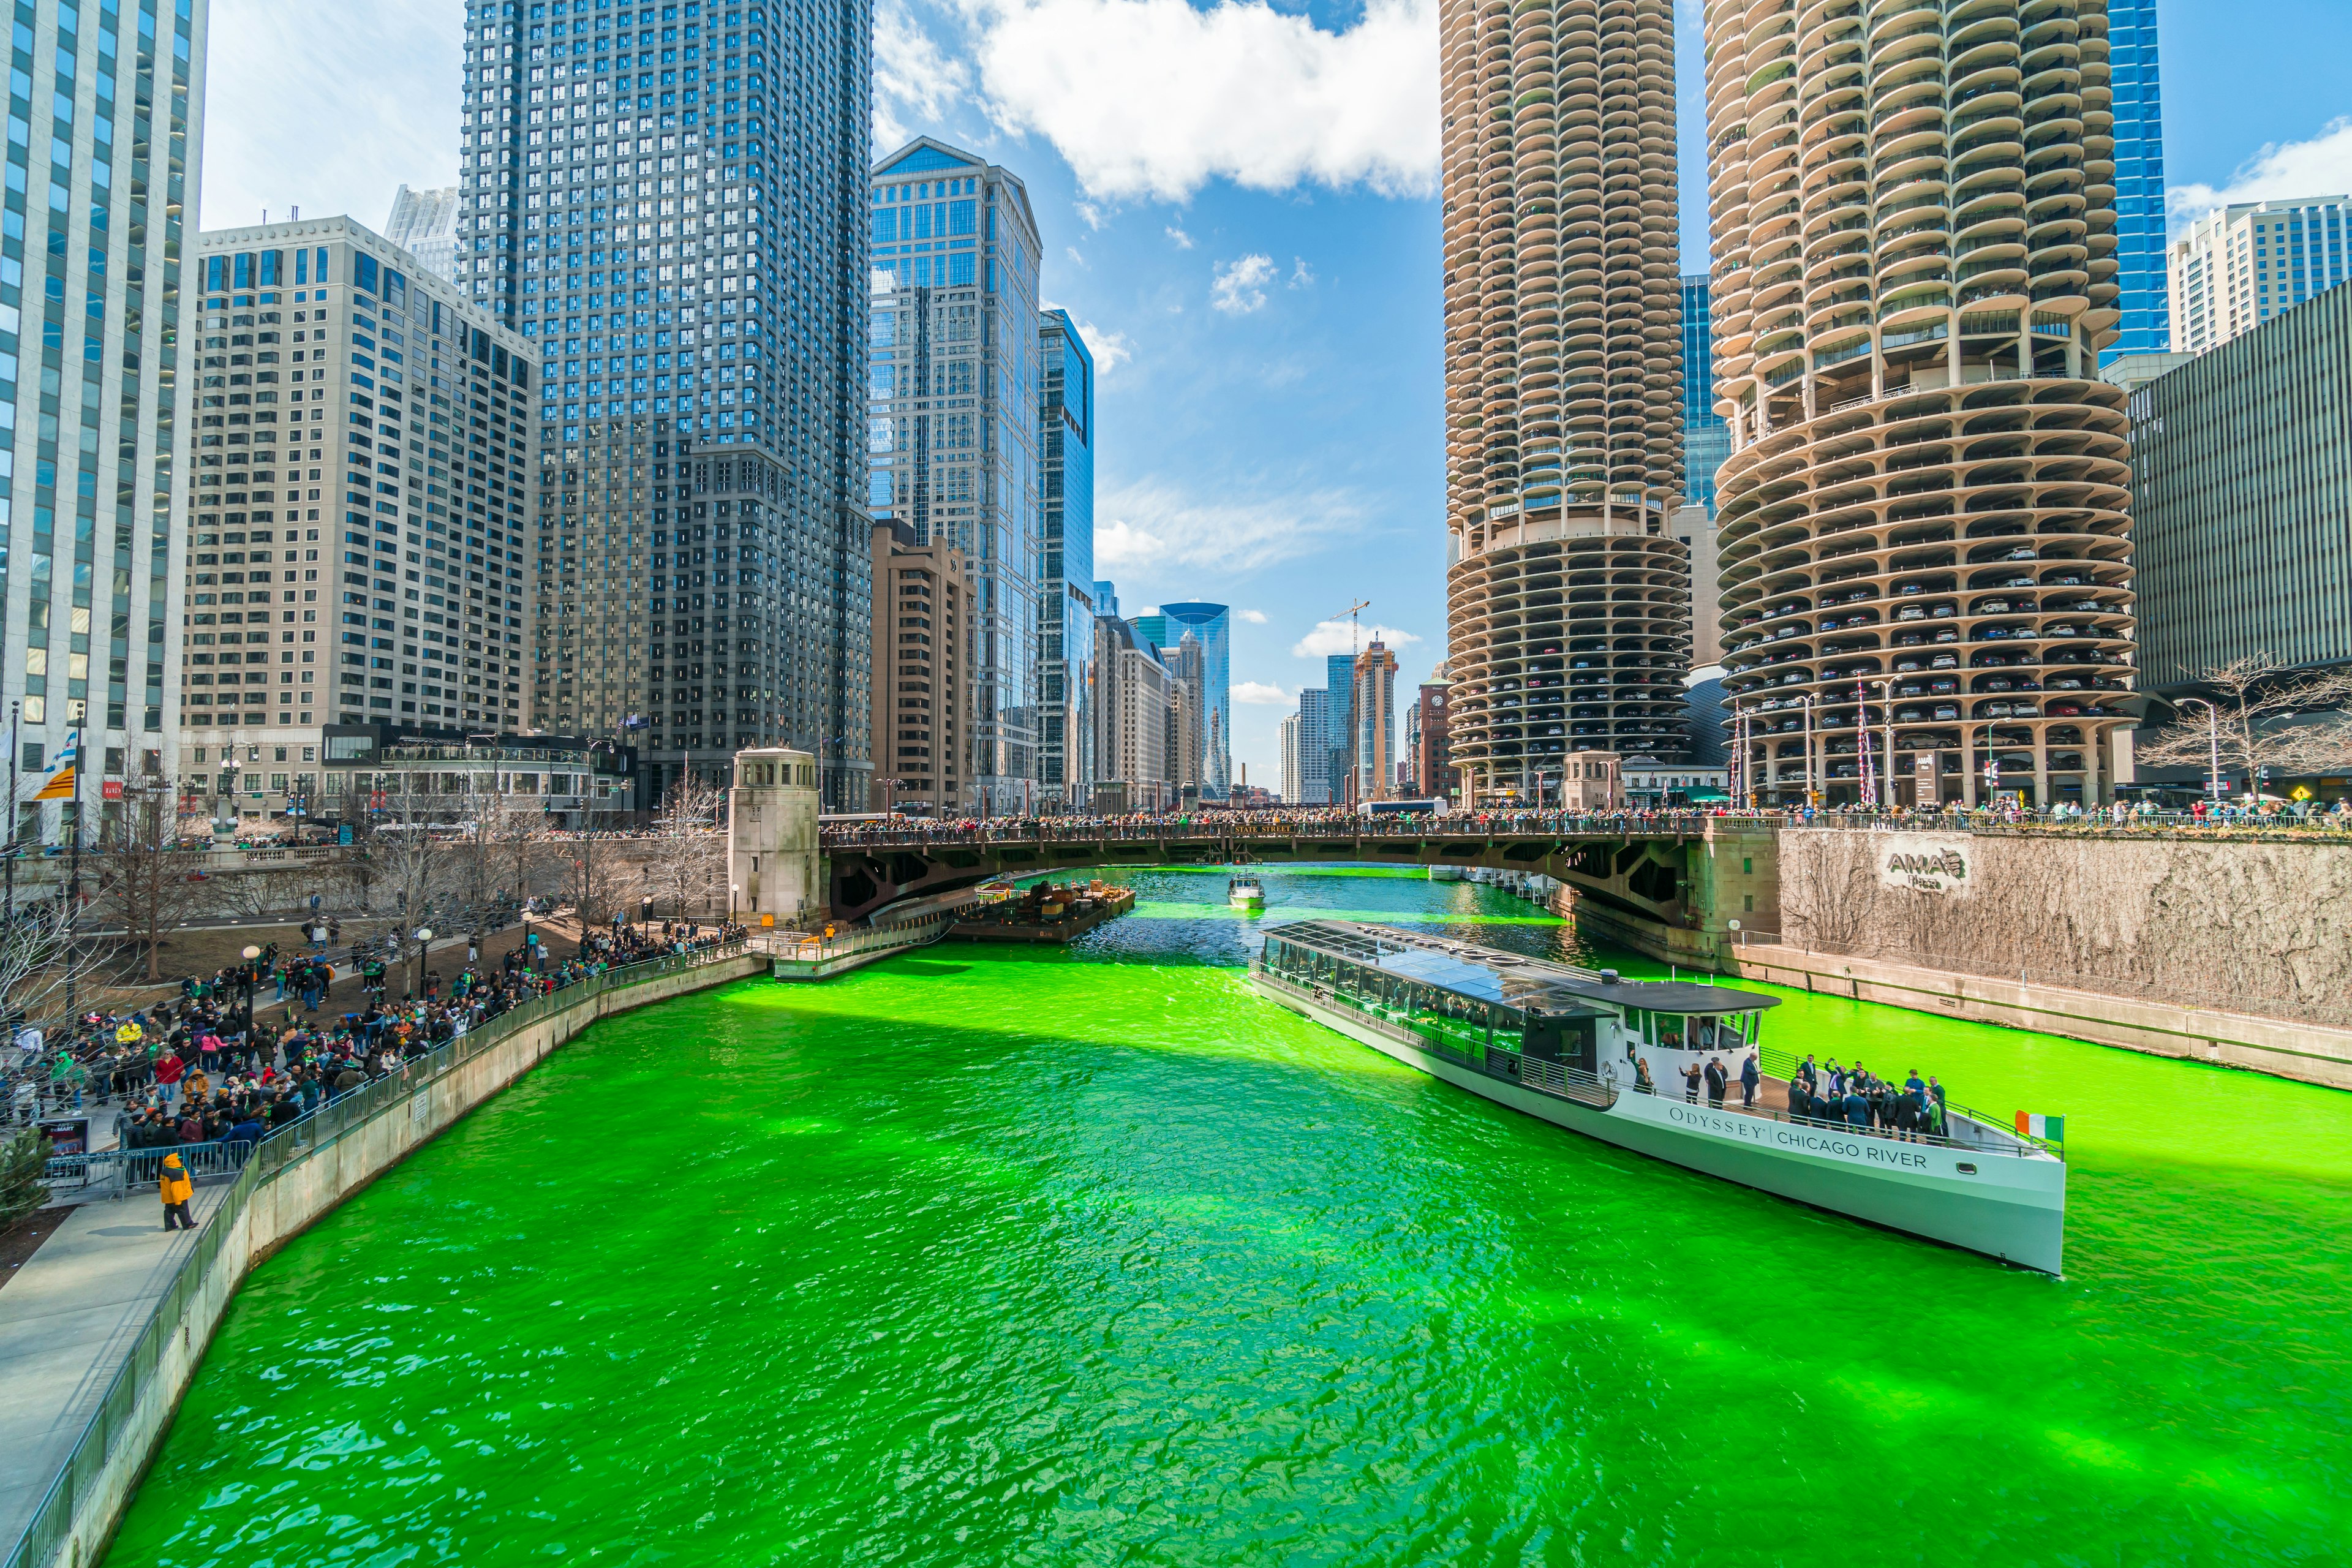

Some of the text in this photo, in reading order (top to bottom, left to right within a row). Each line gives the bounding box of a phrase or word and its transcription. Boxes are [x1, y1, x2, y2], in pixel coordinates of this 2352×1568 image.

[105, 785, 121, 794] mb
[1887, 853, 1948, 873] AMA
[1908, 875, 1938, 886] Plaza
[1670, 1107, 1927, 1169] ODYSSEY CHICAGO RIVER
